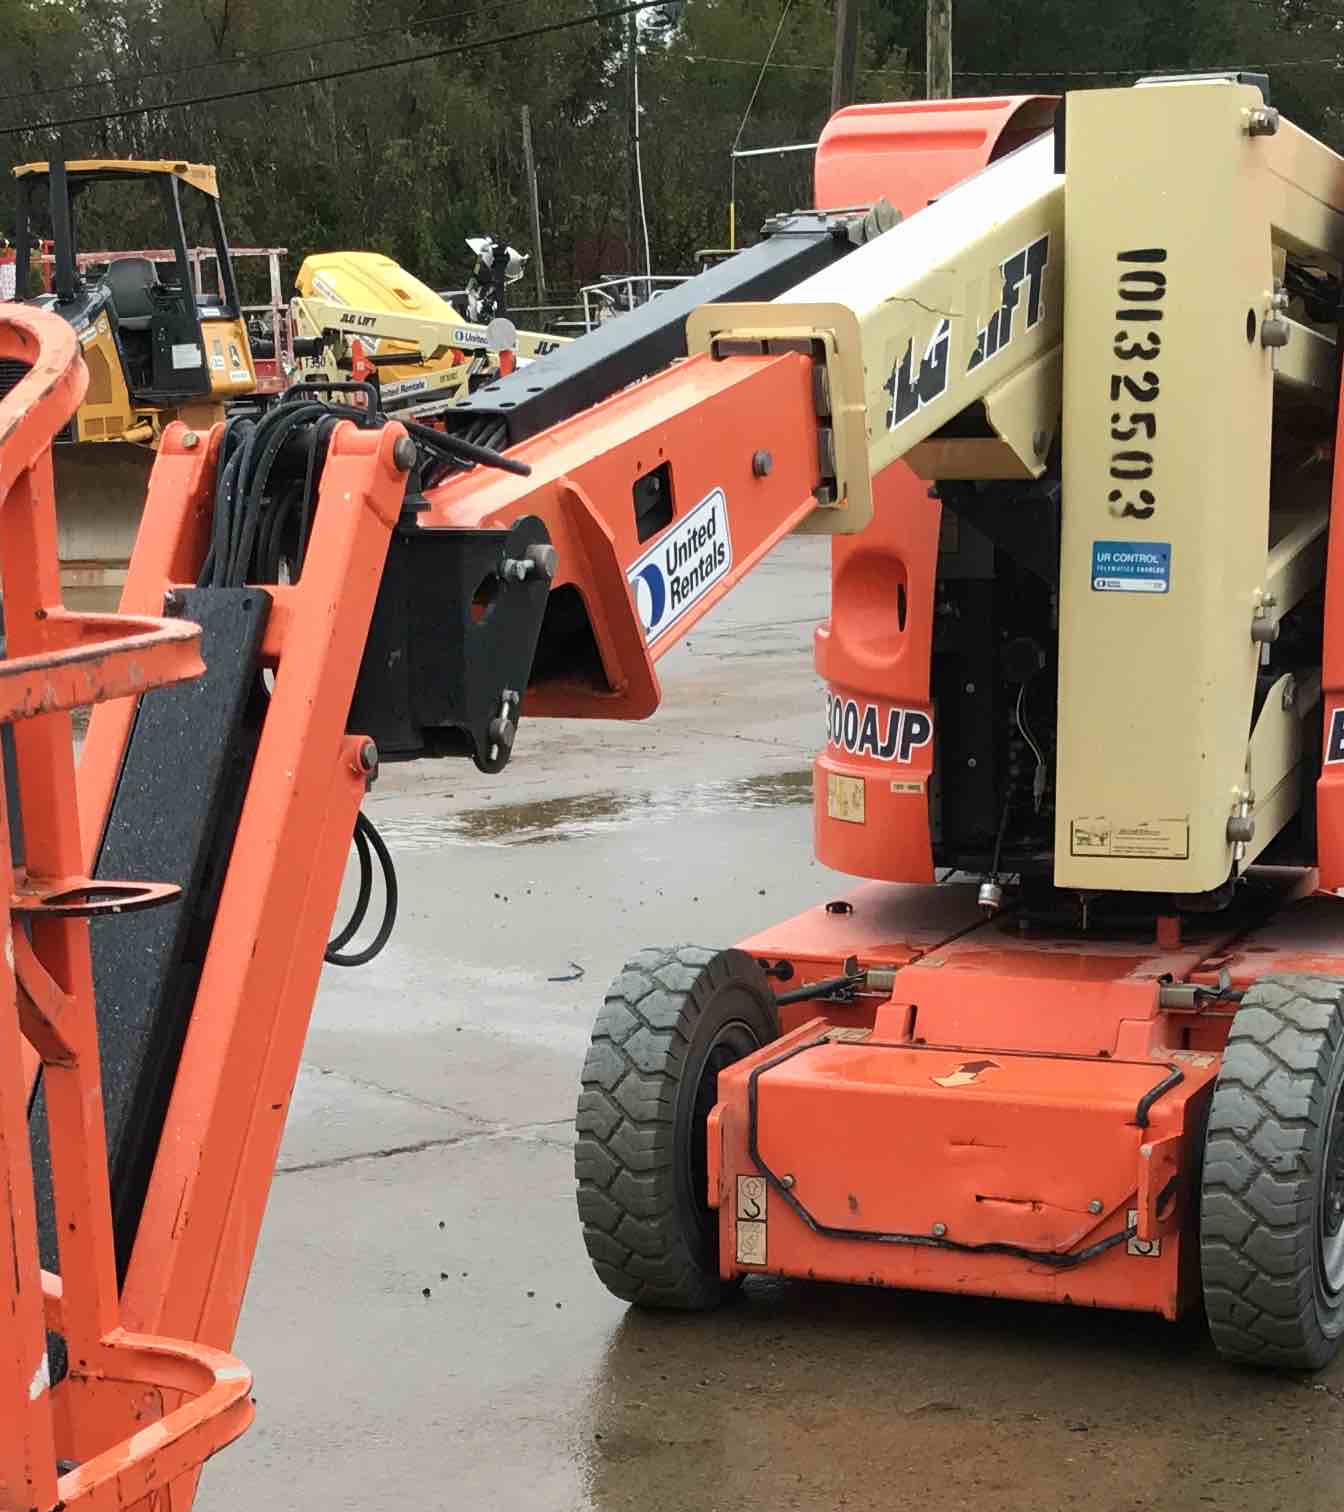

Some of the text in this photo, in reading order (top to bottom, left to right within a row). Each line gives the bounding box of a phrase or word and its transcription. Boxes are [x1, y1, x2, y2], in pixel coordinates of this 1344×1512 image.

[340, 312, 377, 327] JLG LIFT
[884, 318, 951, 432] LG
[1108, 248, 1167, 520] 10132503
[664, 506, 718, 575] United
[668, 540, 727, 611] Rentals
